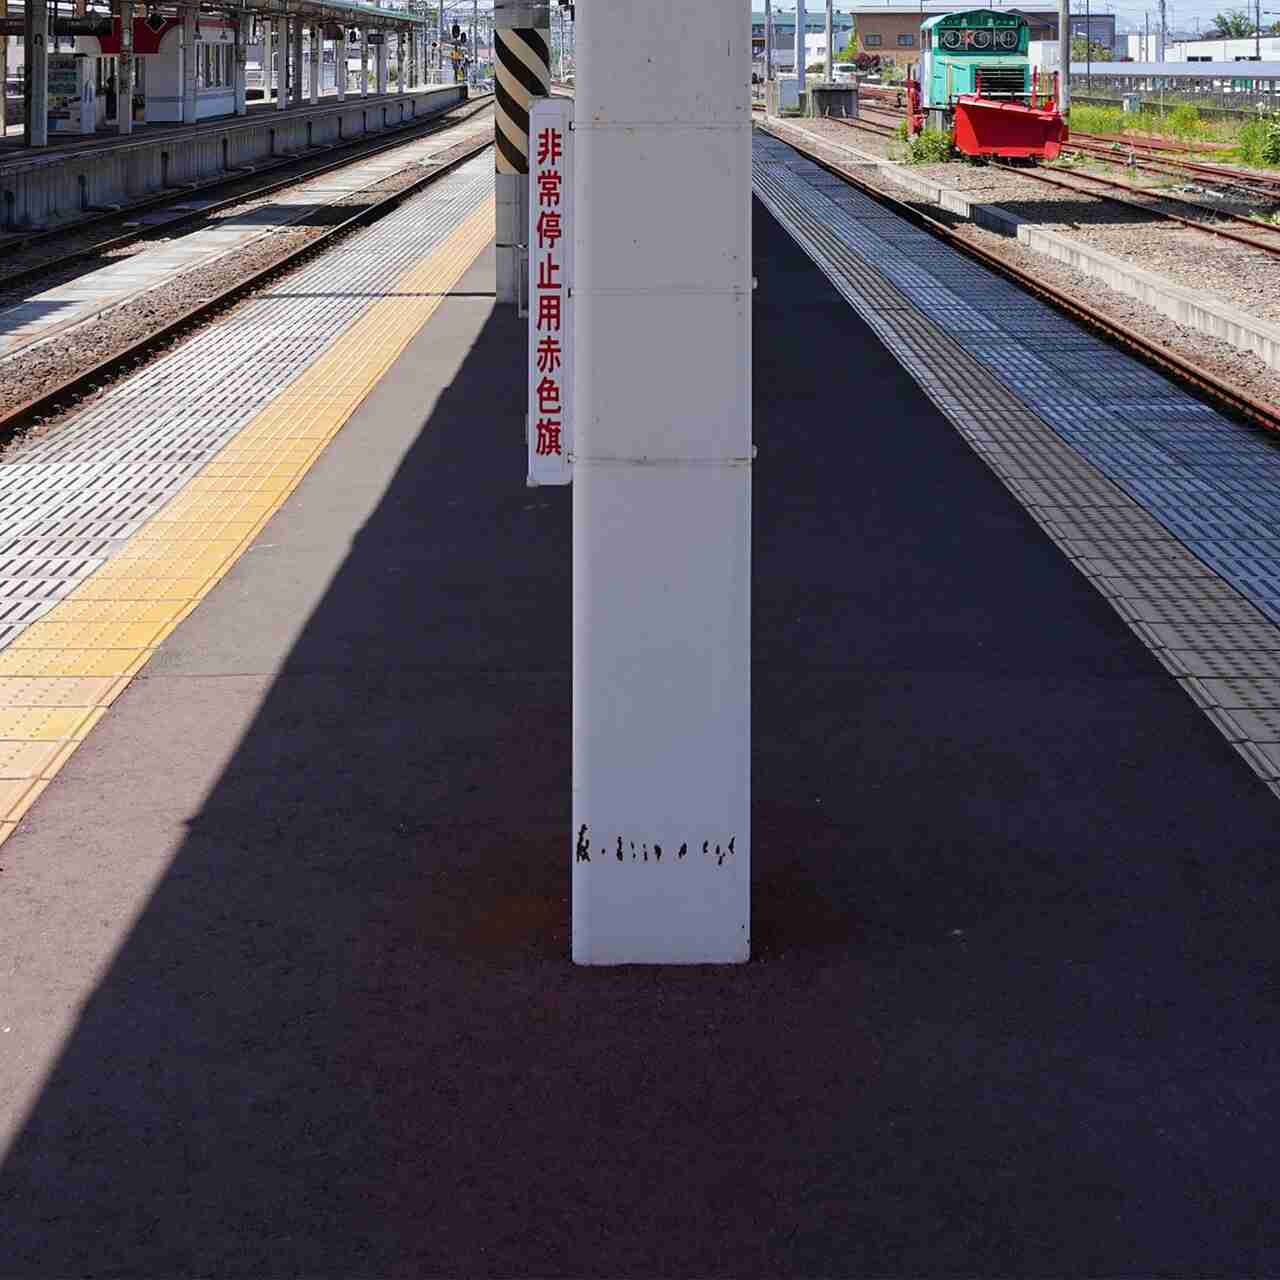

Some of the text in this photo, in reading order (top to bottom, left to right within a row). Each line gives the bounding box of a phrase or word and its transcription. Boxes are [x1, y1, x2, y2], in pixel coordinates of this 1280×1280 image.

[536, 127, 562, 457] 非常停止用赤色旗
